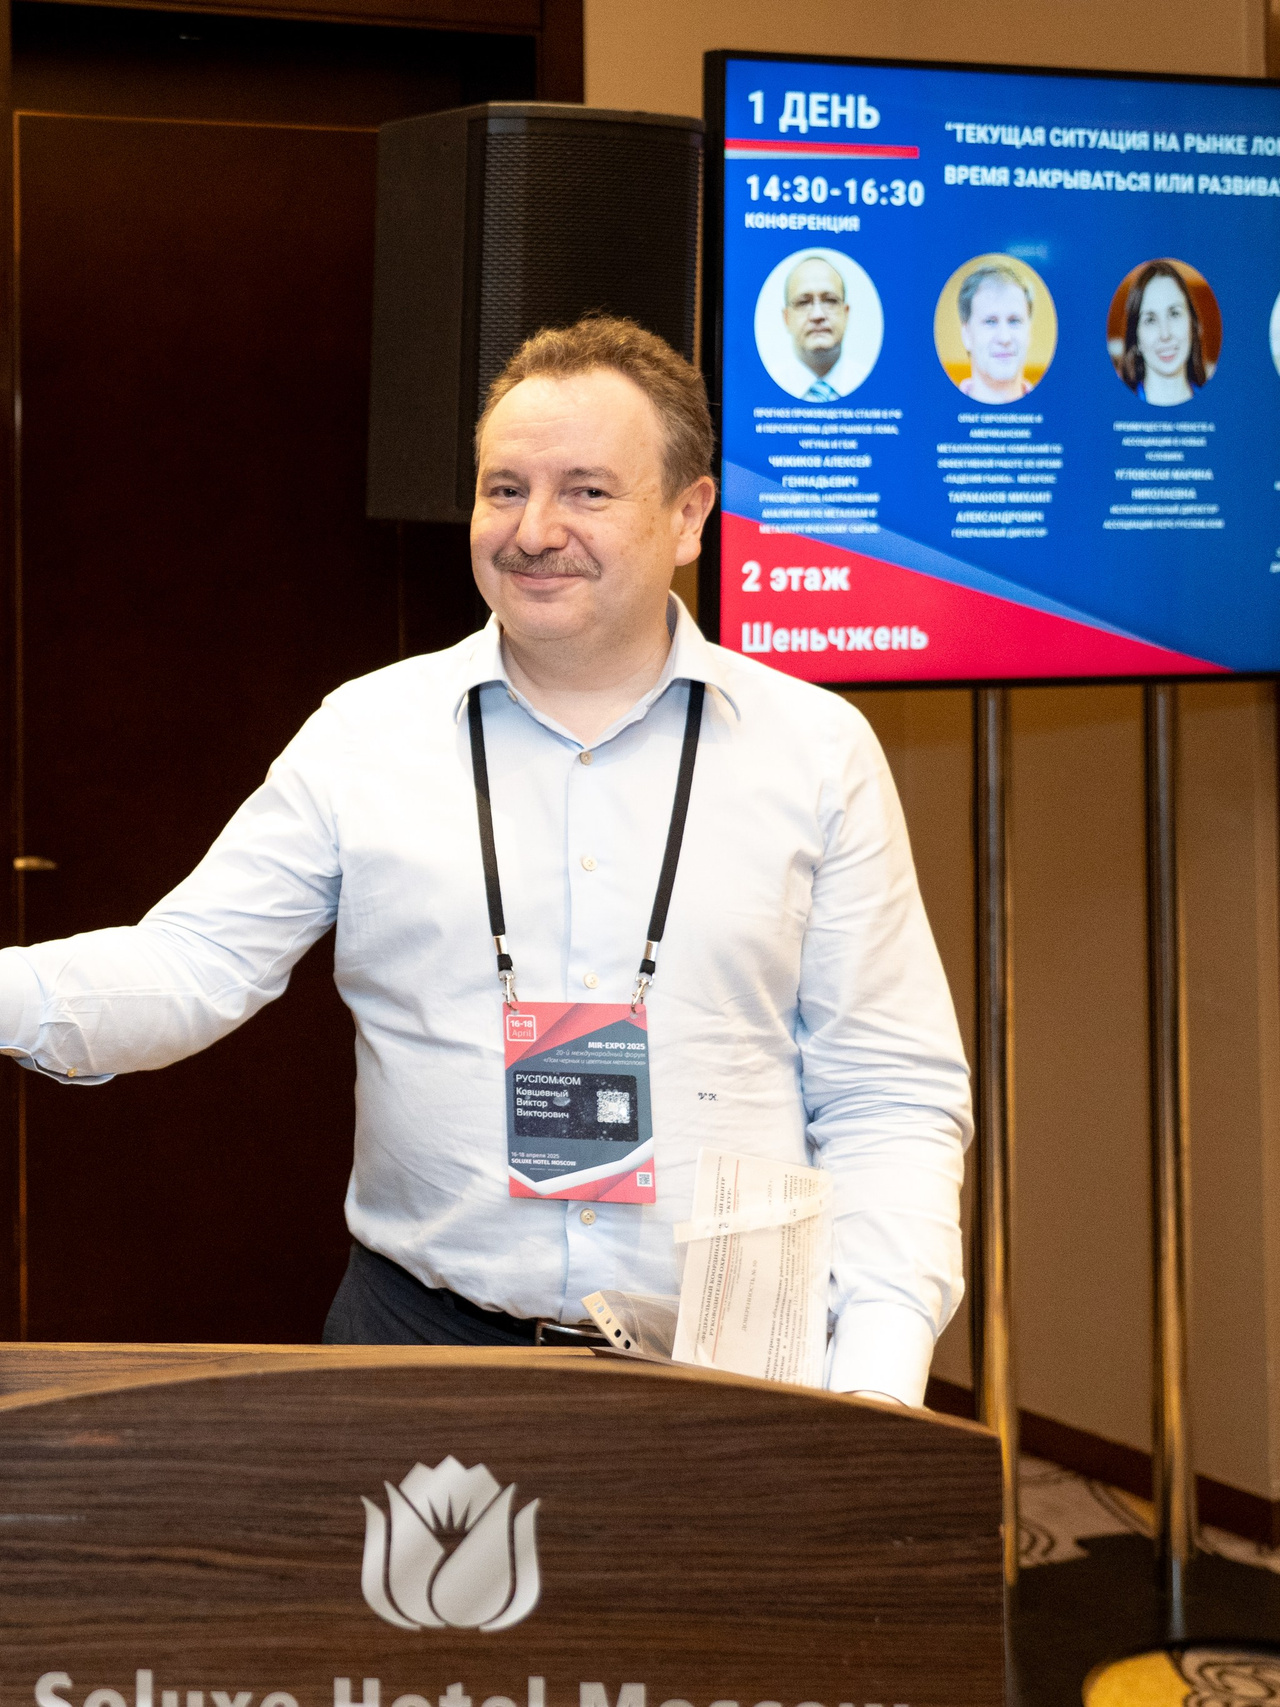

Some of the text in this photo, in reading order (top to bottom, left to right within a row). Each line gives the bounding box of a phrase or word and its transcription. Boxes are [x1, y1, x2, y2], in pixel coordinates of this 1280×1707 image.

[748, 90, 881, 134] 1 ДЕНЬ
[1049, 127, 1150, 154] СИТУАЦИЯ
[1153, 131, 1180, 152] НА
[1184, 132, 1248, 155] РЫНКЕ
[746, 174, 925, 207] 14:30-16:30
[944, 164, 1280, 197] ВРЕМЯ ЗАКРЫВАТЬСЯ ИЛИ РАЗВИВА
[745, 212, 860, 234] КОНФЕРЕНЦИЯ
[742, 560, 851, 592] 2 этаж
[742, 621, 929, 653] Шеньчжень
[510, 1020, 533, 1028] 16-18
[512, 1029, 532, 1038] April
[588, 1041, 645, 1050] MIR-EXPO 2025
[515, 1074, 581, 1085] РУСЛОМ.КОМ
[516, 1087, 569, 1098] Ковшевный
[516, 1098, 548, 1108] Виктор
[516, 1108, 569, 1119] Викторович
[720, 1235, 728, 1272] ОХРАННЫ
